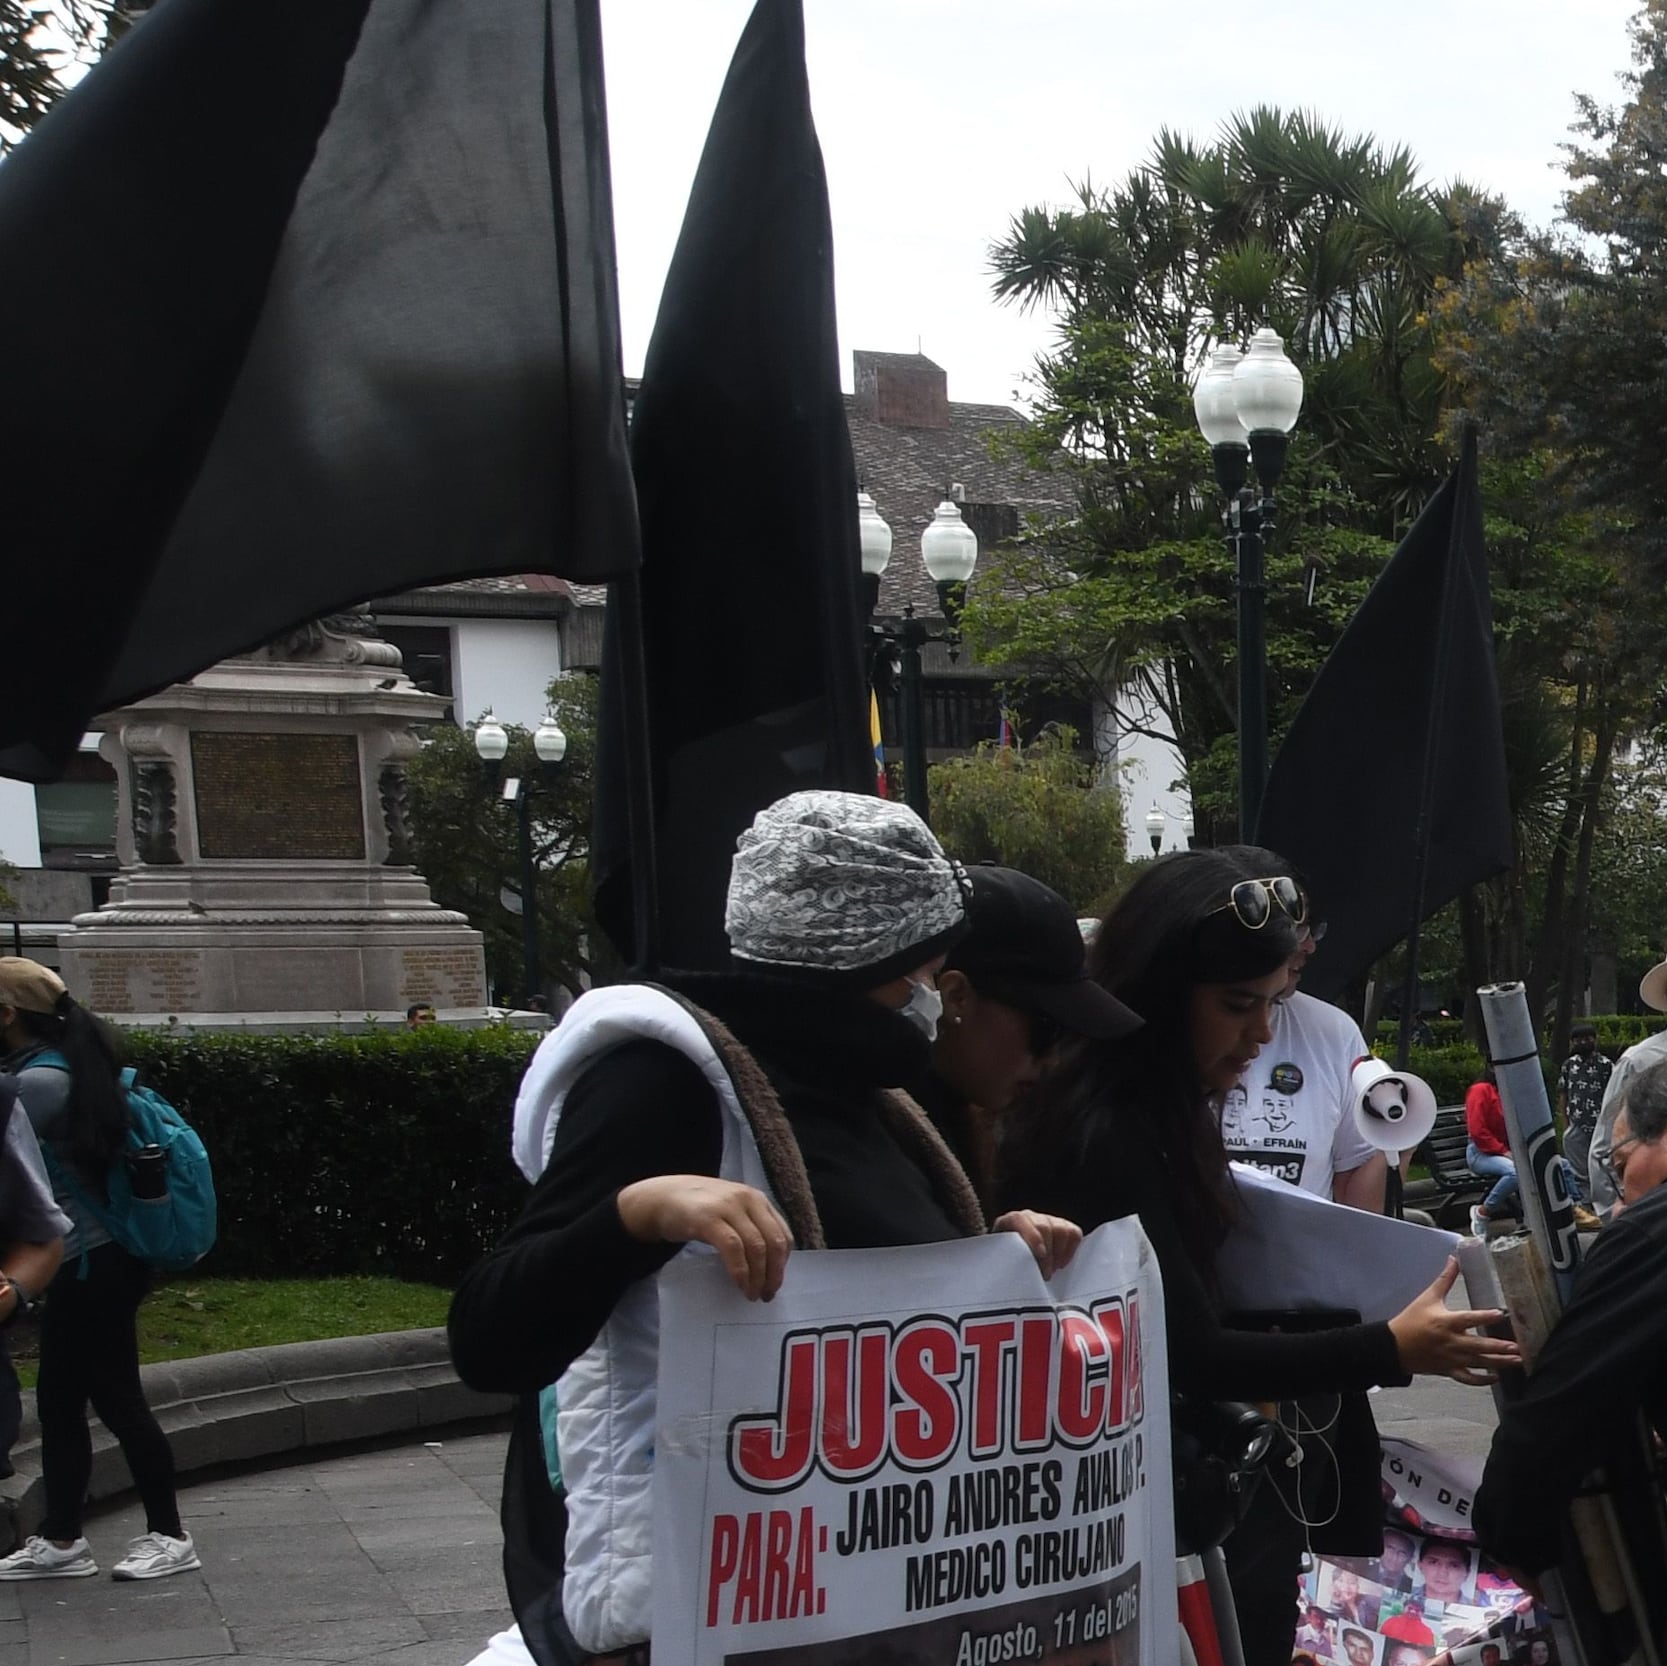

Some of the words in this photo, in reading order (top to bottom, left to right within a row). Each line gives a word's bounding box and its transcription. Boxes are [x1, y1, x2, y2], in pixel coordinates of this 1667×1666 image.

[1223, 1134, 1249, 1148] AÚL
[1263, 1136, 1307, 1150] EFRAÍN
[727, 1289, 1146, 1494] JUSTICIA
[836, 1480, 934, 1557] JAIRO
[944, 1460, 1063, 1537] ANDRES
[1072, 1446, 1134, 1516] AVALOS
[705, 1505, 828, 1628] PARA:
[905, 1546, 1007, 1612] MEDICO
[1015, 1512, 1126, 1586] CIRUJANO
[1054, 1608, 1078, 1645] 11
[1084, 1599, 1112, 1639] del
[1115, 1584, 1138, 1632] 2015
